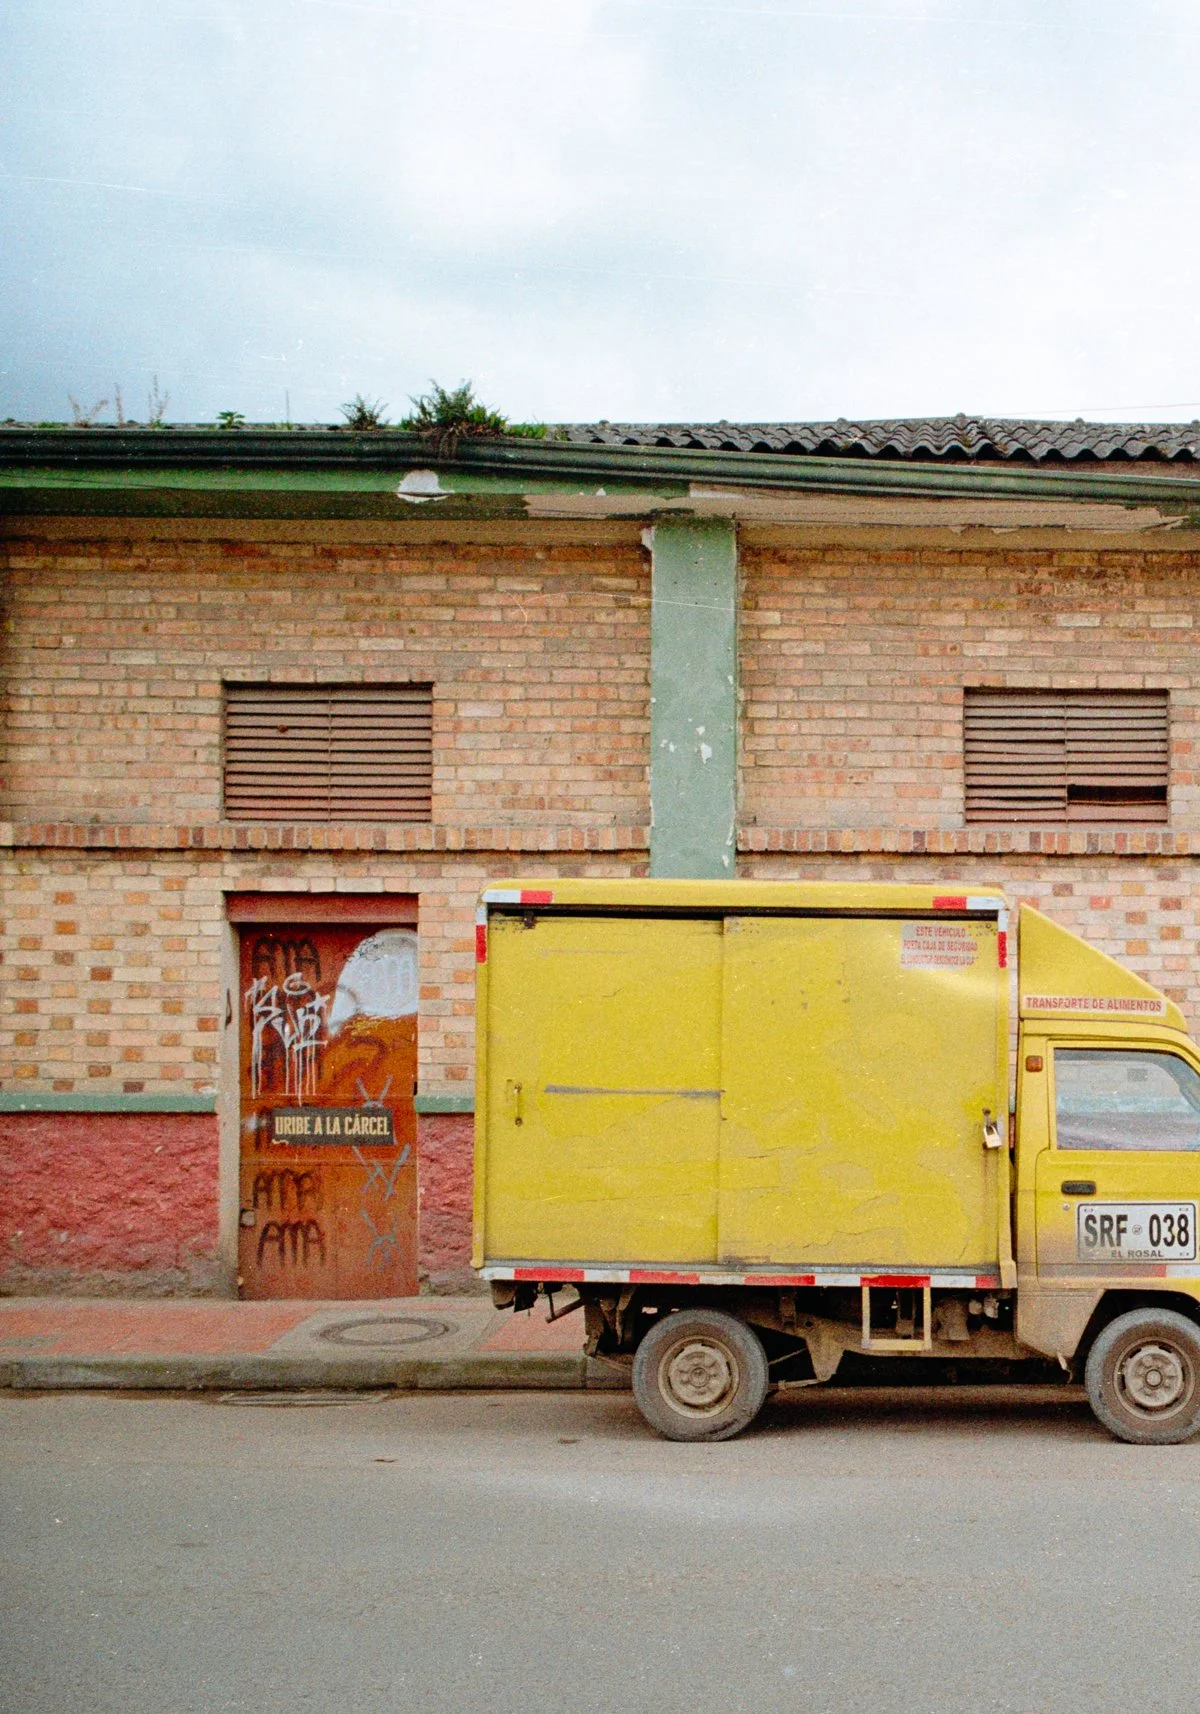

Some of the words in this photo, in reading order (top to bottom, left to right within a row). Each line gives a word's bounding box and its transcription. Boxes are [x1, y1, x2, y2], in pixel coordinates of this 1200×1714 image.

[916, 926, 932, 937] ESTE
[934, 927, 966, 938] VEHICULO
[1026, 997, 1089, 1009] TRANSPORTE
[1092, 999, 1104, 1009] DE
[1107, 1000, 1162, 1012] ALIMENTOS
[274, 1116, 310, 1135] URIBE
[314, 1116, 323, 1135] A
[326, 1116, 340, 1135] LA
[344, 1114, 390, 1136] CÁRCEL
[1084, 1213, 1128, 1248] SRF
[1149, 1213, 1190, 1247] 038
[1111, 1250, 1123, 1258] EL
[1128, 1250, 1165, 1258] ROSAL
